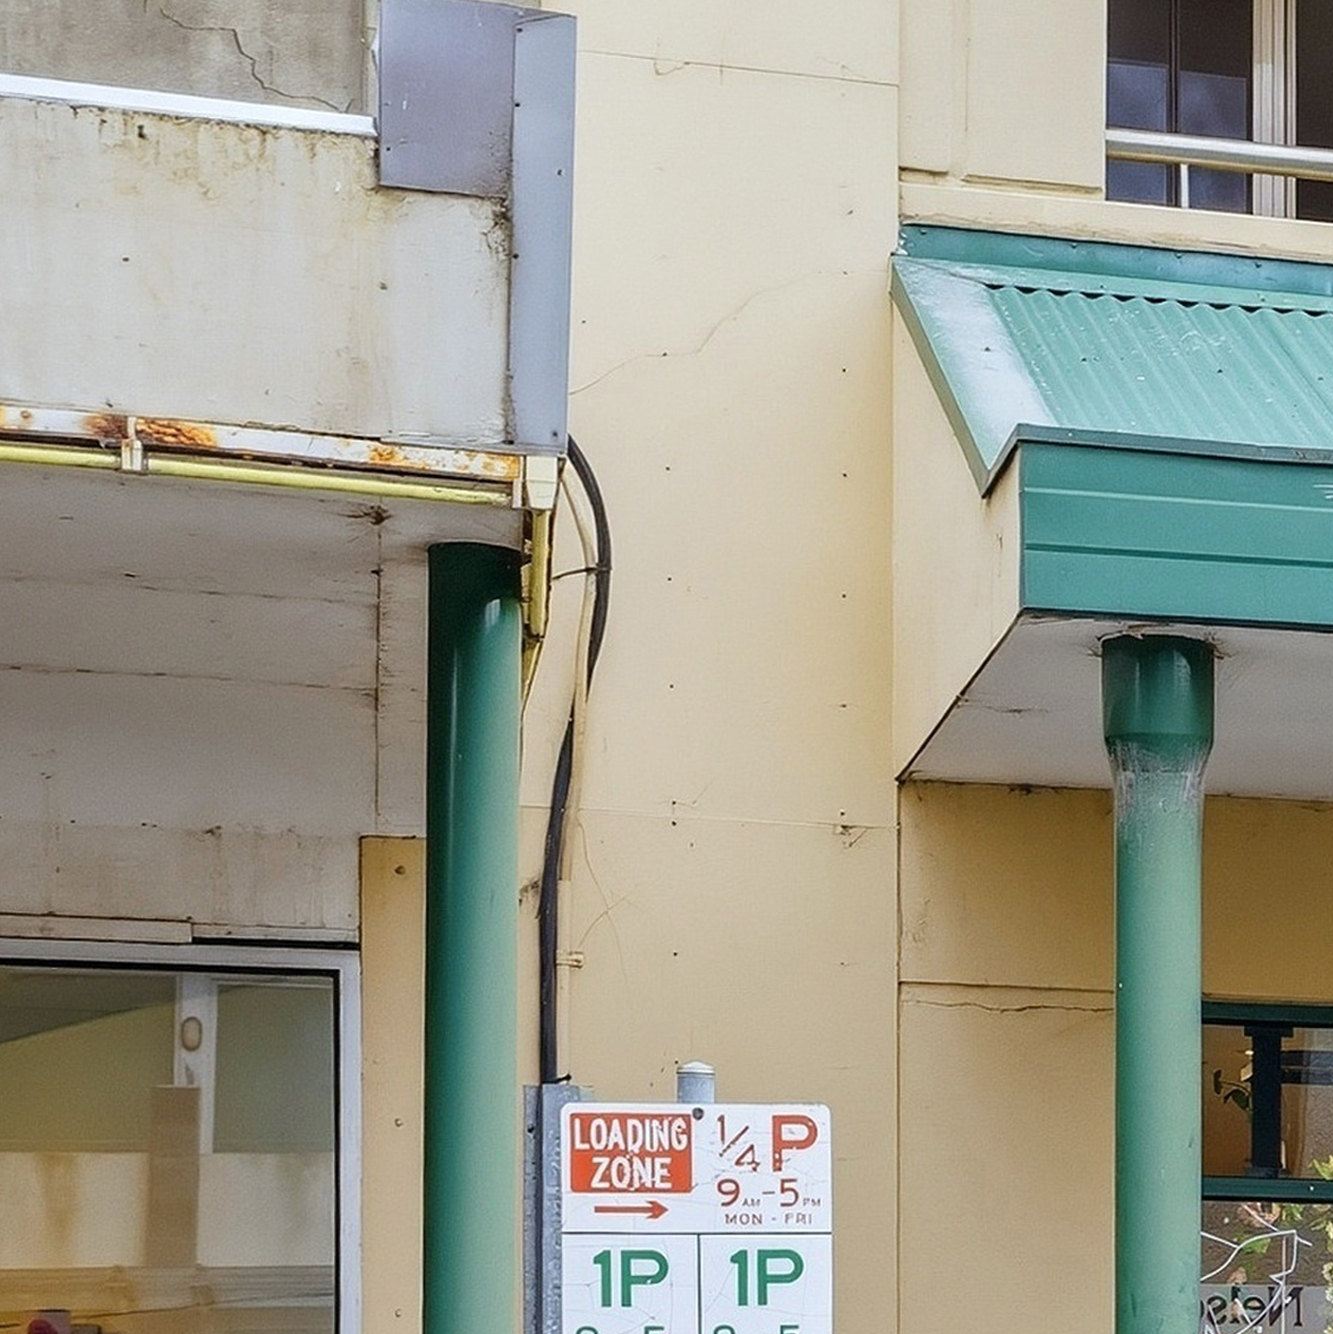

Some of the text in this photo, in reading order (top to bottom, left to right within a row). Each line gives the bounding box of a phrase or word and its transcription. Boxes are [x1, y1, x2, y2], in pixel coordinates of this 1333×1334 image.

[573, 1116, 689, 1153] LOADING
[590, 1155, 673, 1191] ZONE
[592, 1249, 669, 1308] 1P
[729, 1248, 804, 1307] 1P
